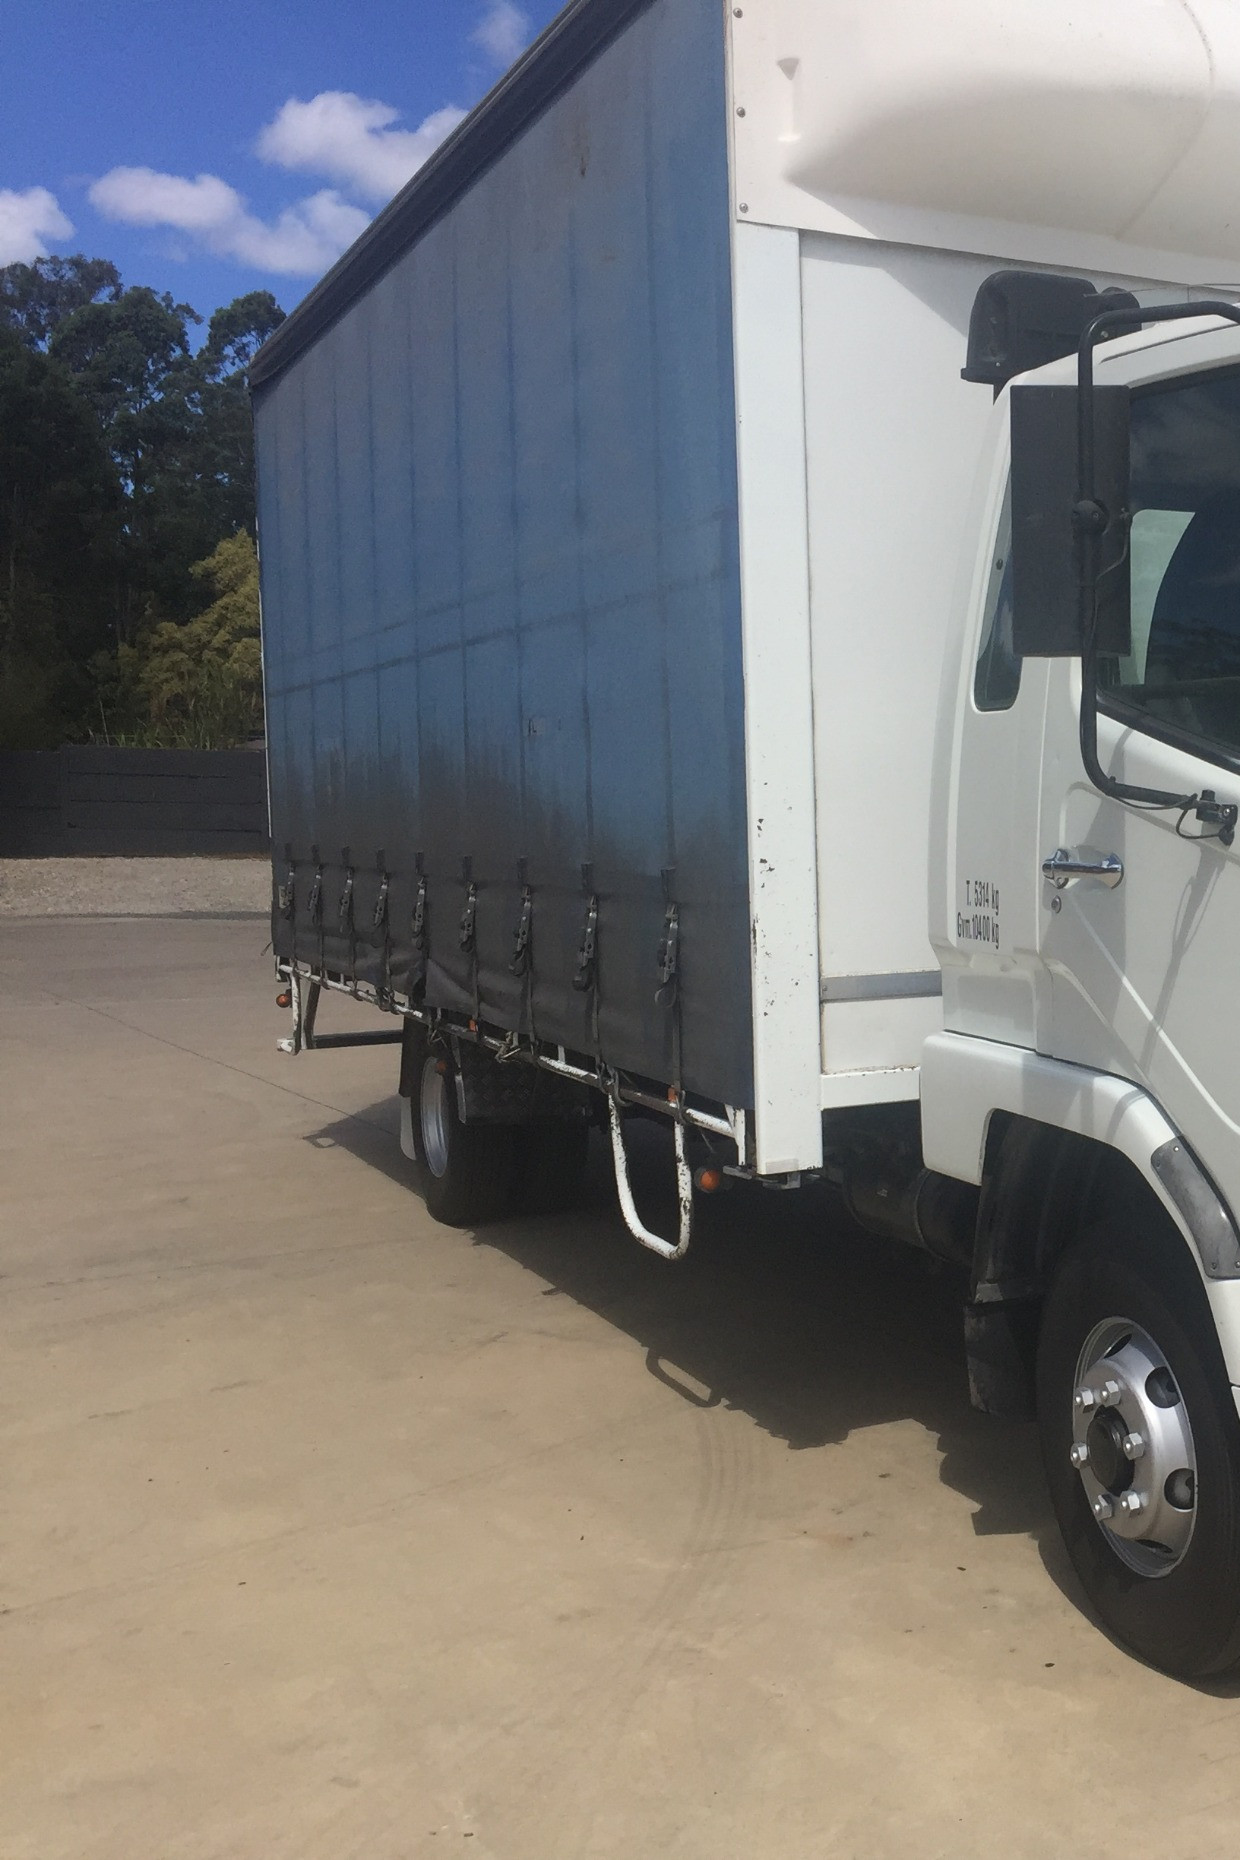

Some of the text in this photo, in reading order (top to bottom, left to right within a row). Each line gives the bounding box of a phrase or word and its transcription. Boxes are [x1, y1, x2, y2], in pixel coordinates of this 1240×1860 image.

[974, 880, 989, 907] 5314
[991, 882, 999, 916] kg
[972, 914, 990, 942] 10400
[991, 917, 999, 949] kg
